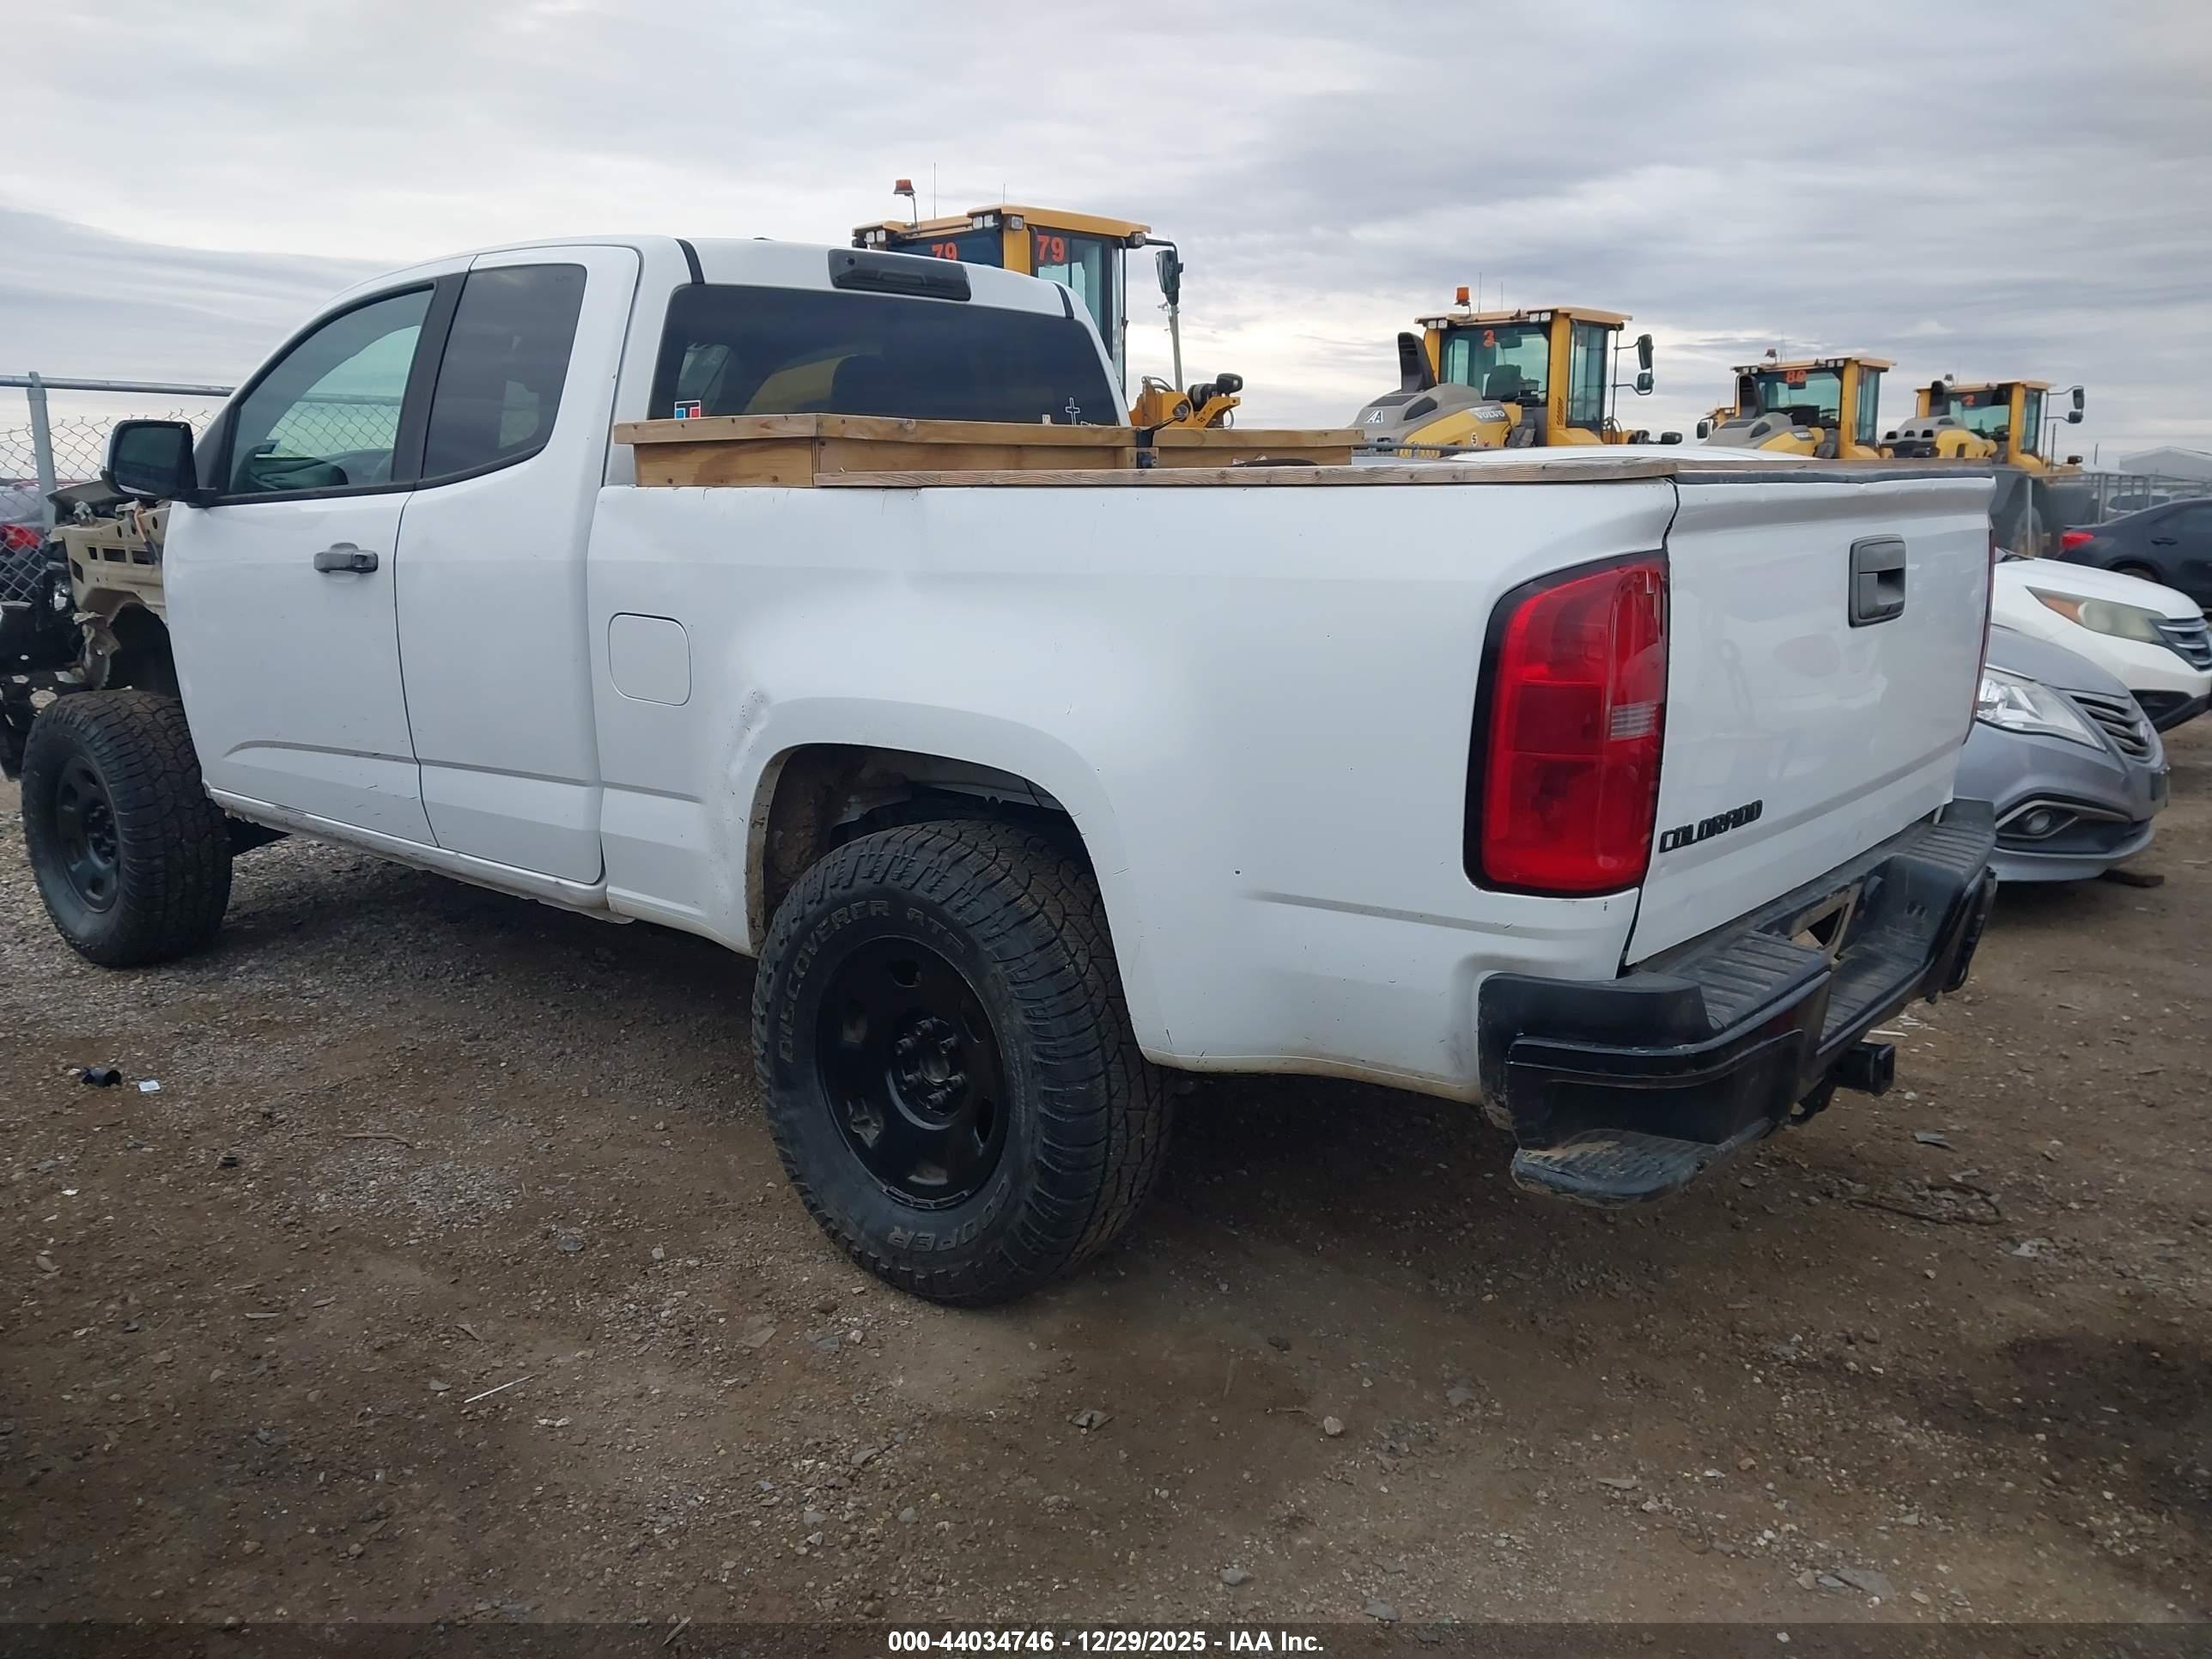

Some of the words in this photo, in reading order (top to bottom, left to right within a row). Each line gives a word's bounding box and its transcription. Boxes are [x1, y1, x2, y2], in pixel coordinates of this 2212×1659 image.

[1036, 234, 1065, 262] 79
[1483, 329, 1495, 348] 3
[1475, 410, 1505, 420] VOLVO
[1658, 799, 1763, 854] COLORADO
[778, 899, 892, 1064] DISCOVERER
[885, 1174, 1012, 1253] COOPER
